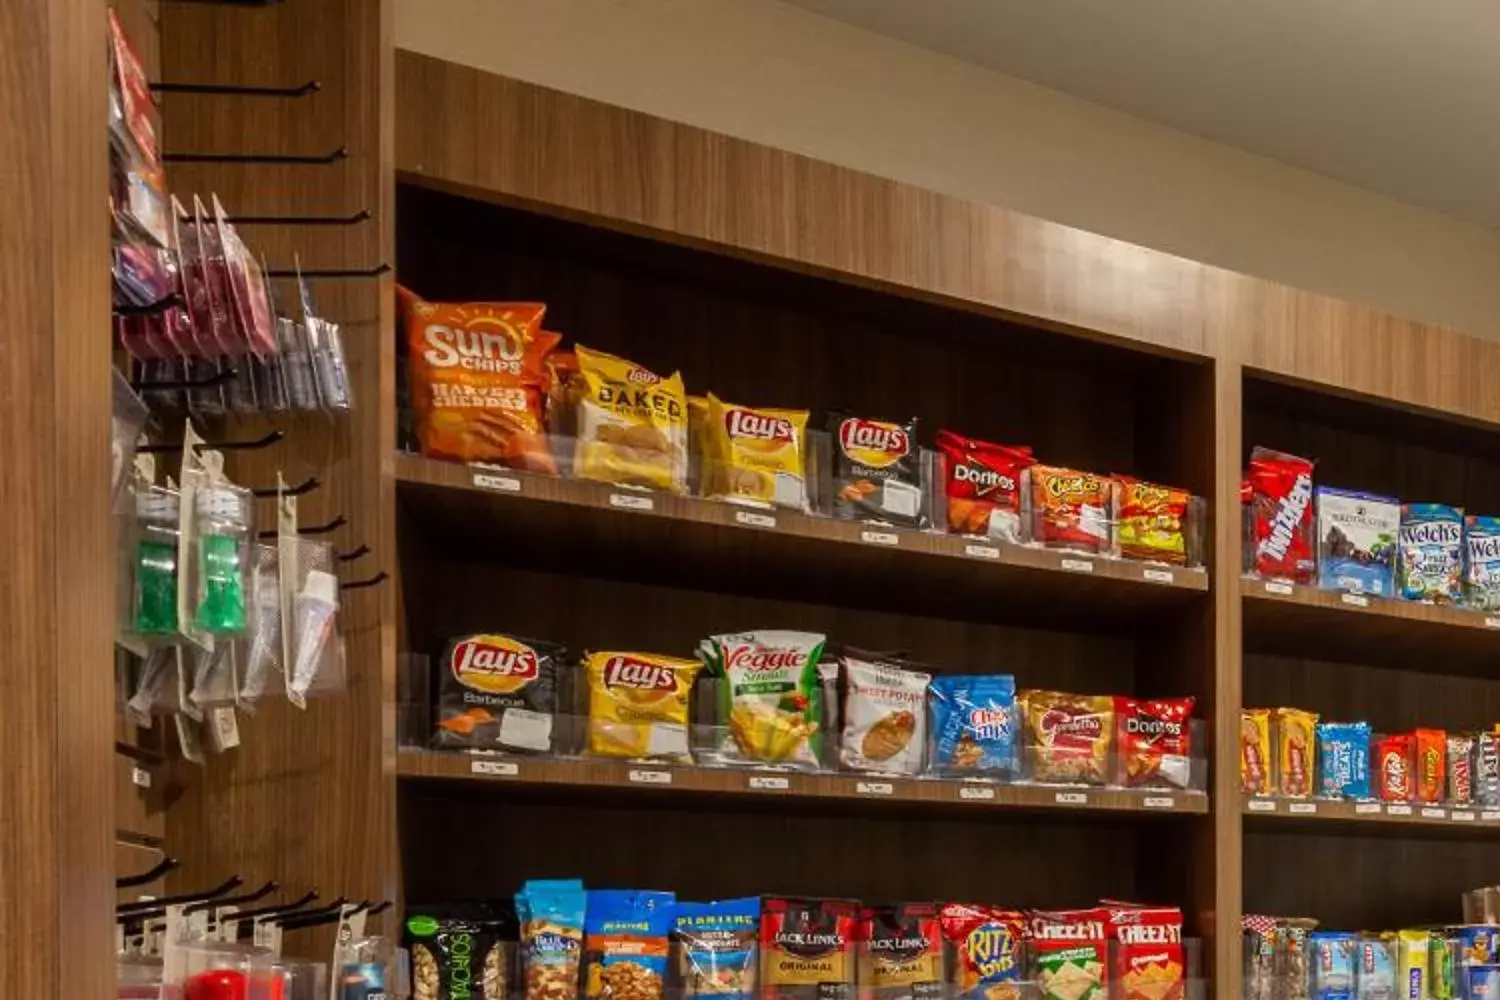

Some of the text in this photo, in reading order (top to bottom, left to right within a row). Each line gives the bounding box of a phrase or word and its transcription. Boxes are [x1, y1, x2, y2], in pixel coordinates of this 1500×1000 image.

[424, 324, 523, 367] Sun
[599, 386, 682, 417] BAKED
[954, 464, 1015, 490] Doritos
[1401, 524, 1459, 544] Welch's
[721, 643, 808, 671] Veggie
[1127, 717, 1181, 735] Doritos
[967, 929, 1015, 959] RITZ
[779, 961, 833, 972] ORIGINAL
